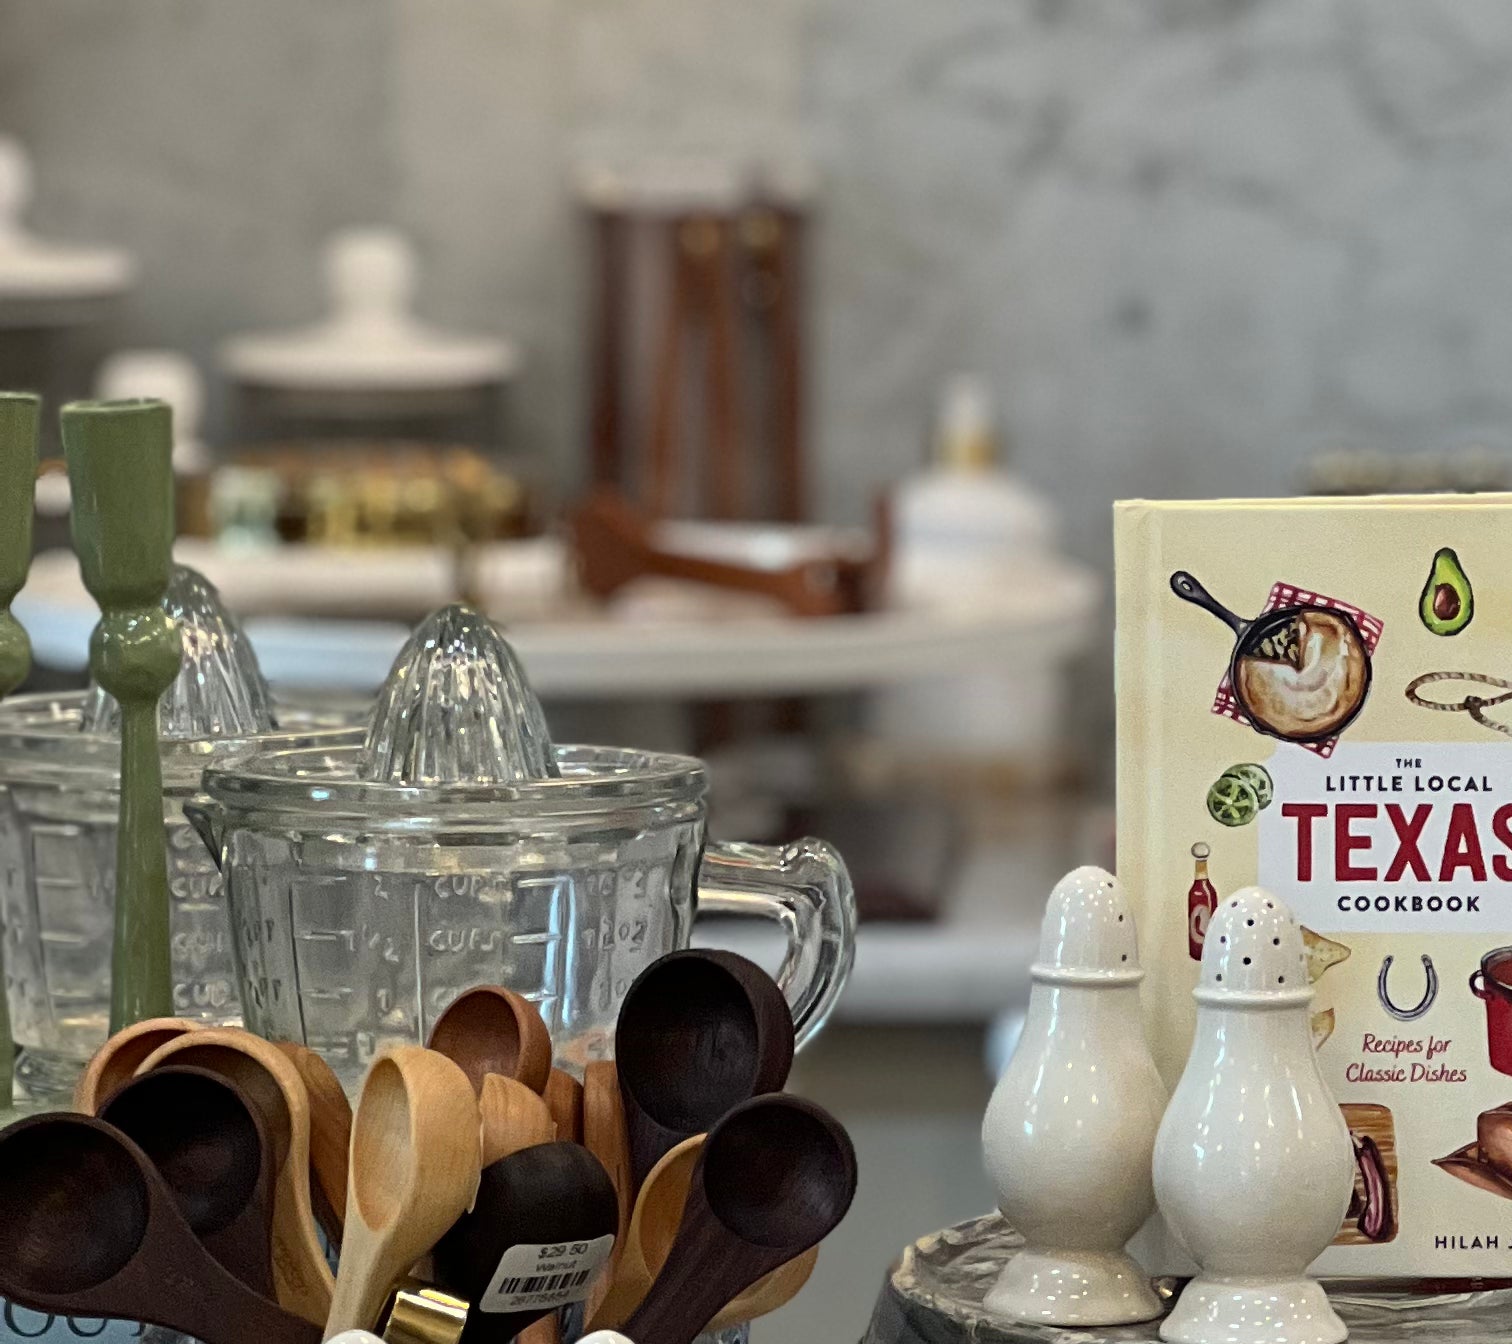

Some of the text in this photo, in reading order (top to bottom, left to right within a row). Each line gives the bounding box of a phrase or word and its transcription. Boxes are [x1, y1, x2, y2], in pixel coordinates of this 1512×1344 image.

[1396, 758, 1422, 769] THE
[1325, 775, 1493, 792] LITTLE LOCAL
[1336, 895, 1481, 913] COOKBOOK
[1361, 1033, 1453, 1060] Recipes for
[1345, 1062, 1468, 1083] Classic Dishes
[1434, 1235, 1499, 1250] HILAH
